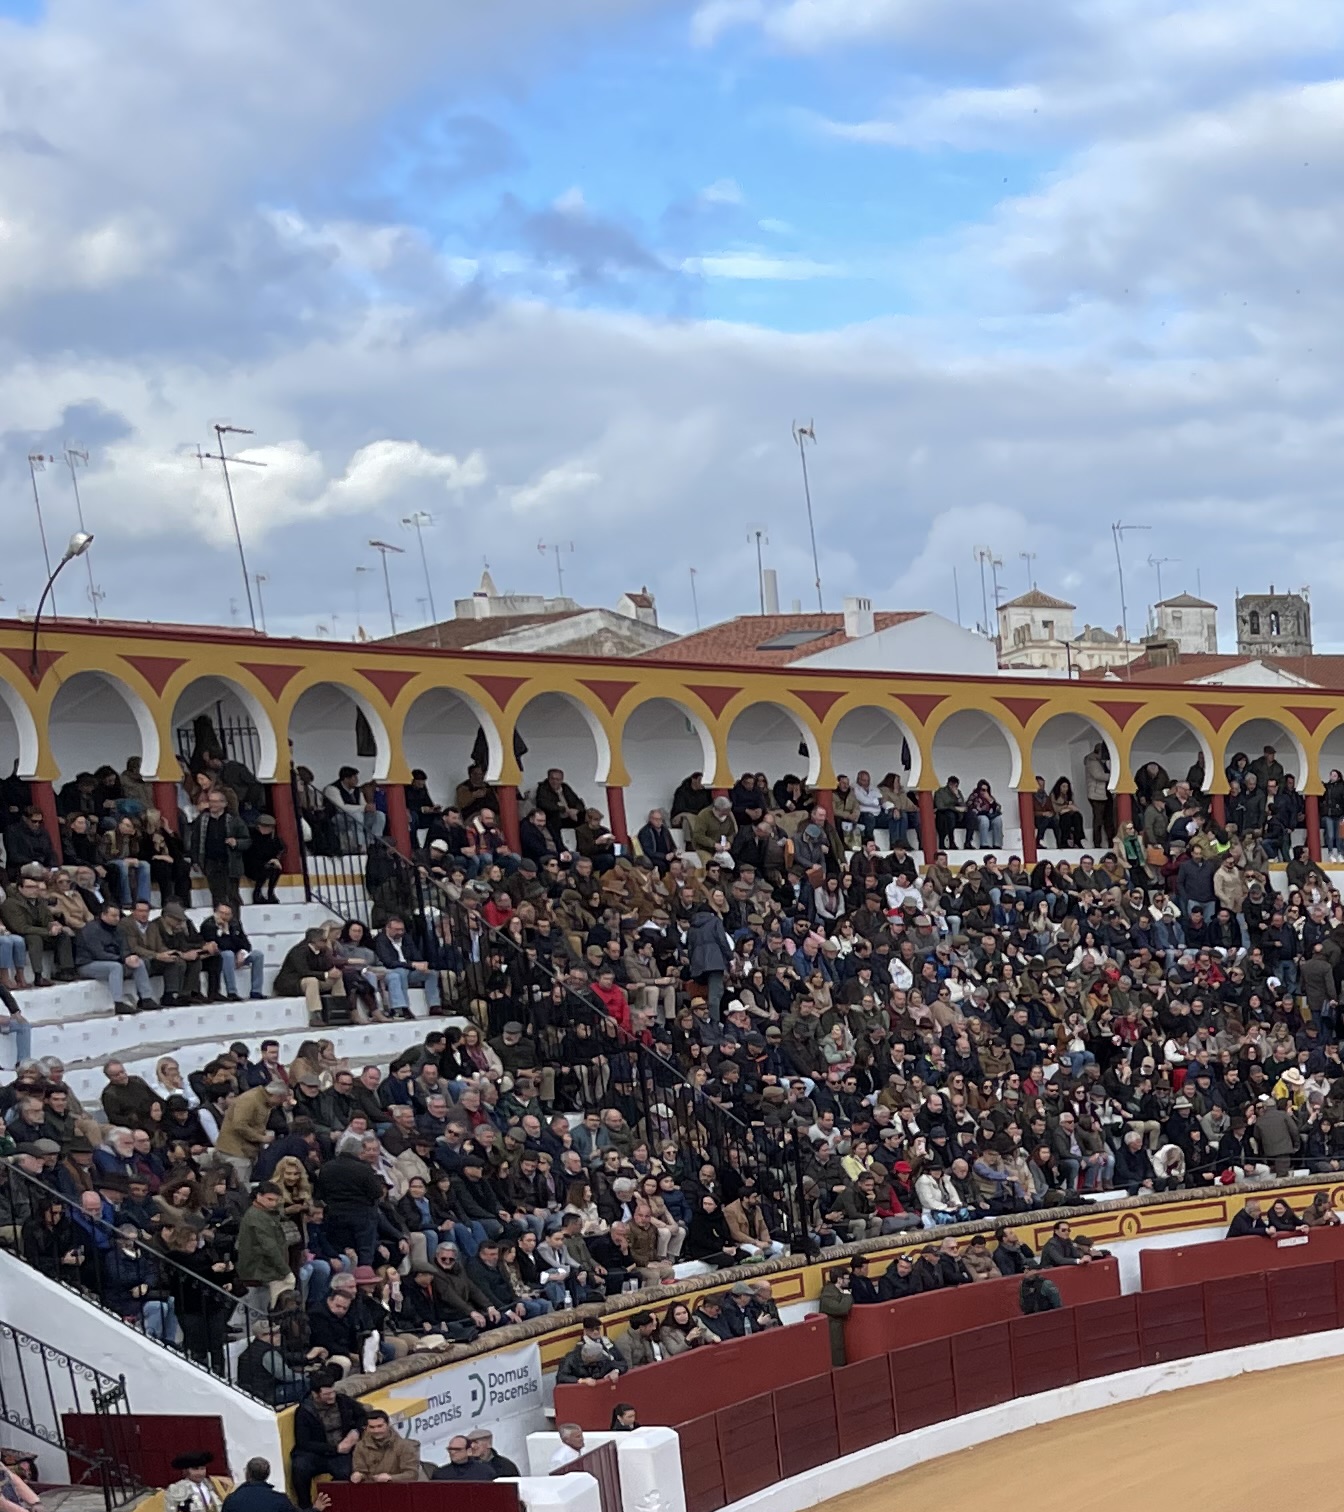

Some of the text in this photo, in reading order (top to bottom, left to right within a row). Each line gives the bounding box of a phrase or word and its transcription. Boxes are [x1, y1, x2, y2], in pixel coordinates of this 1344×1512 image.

[488, 1365, 529, 1388] Domus
[489, 1378, 538, 1406] Pacensis
[415, 1404, 462, 1434] Pacensis
